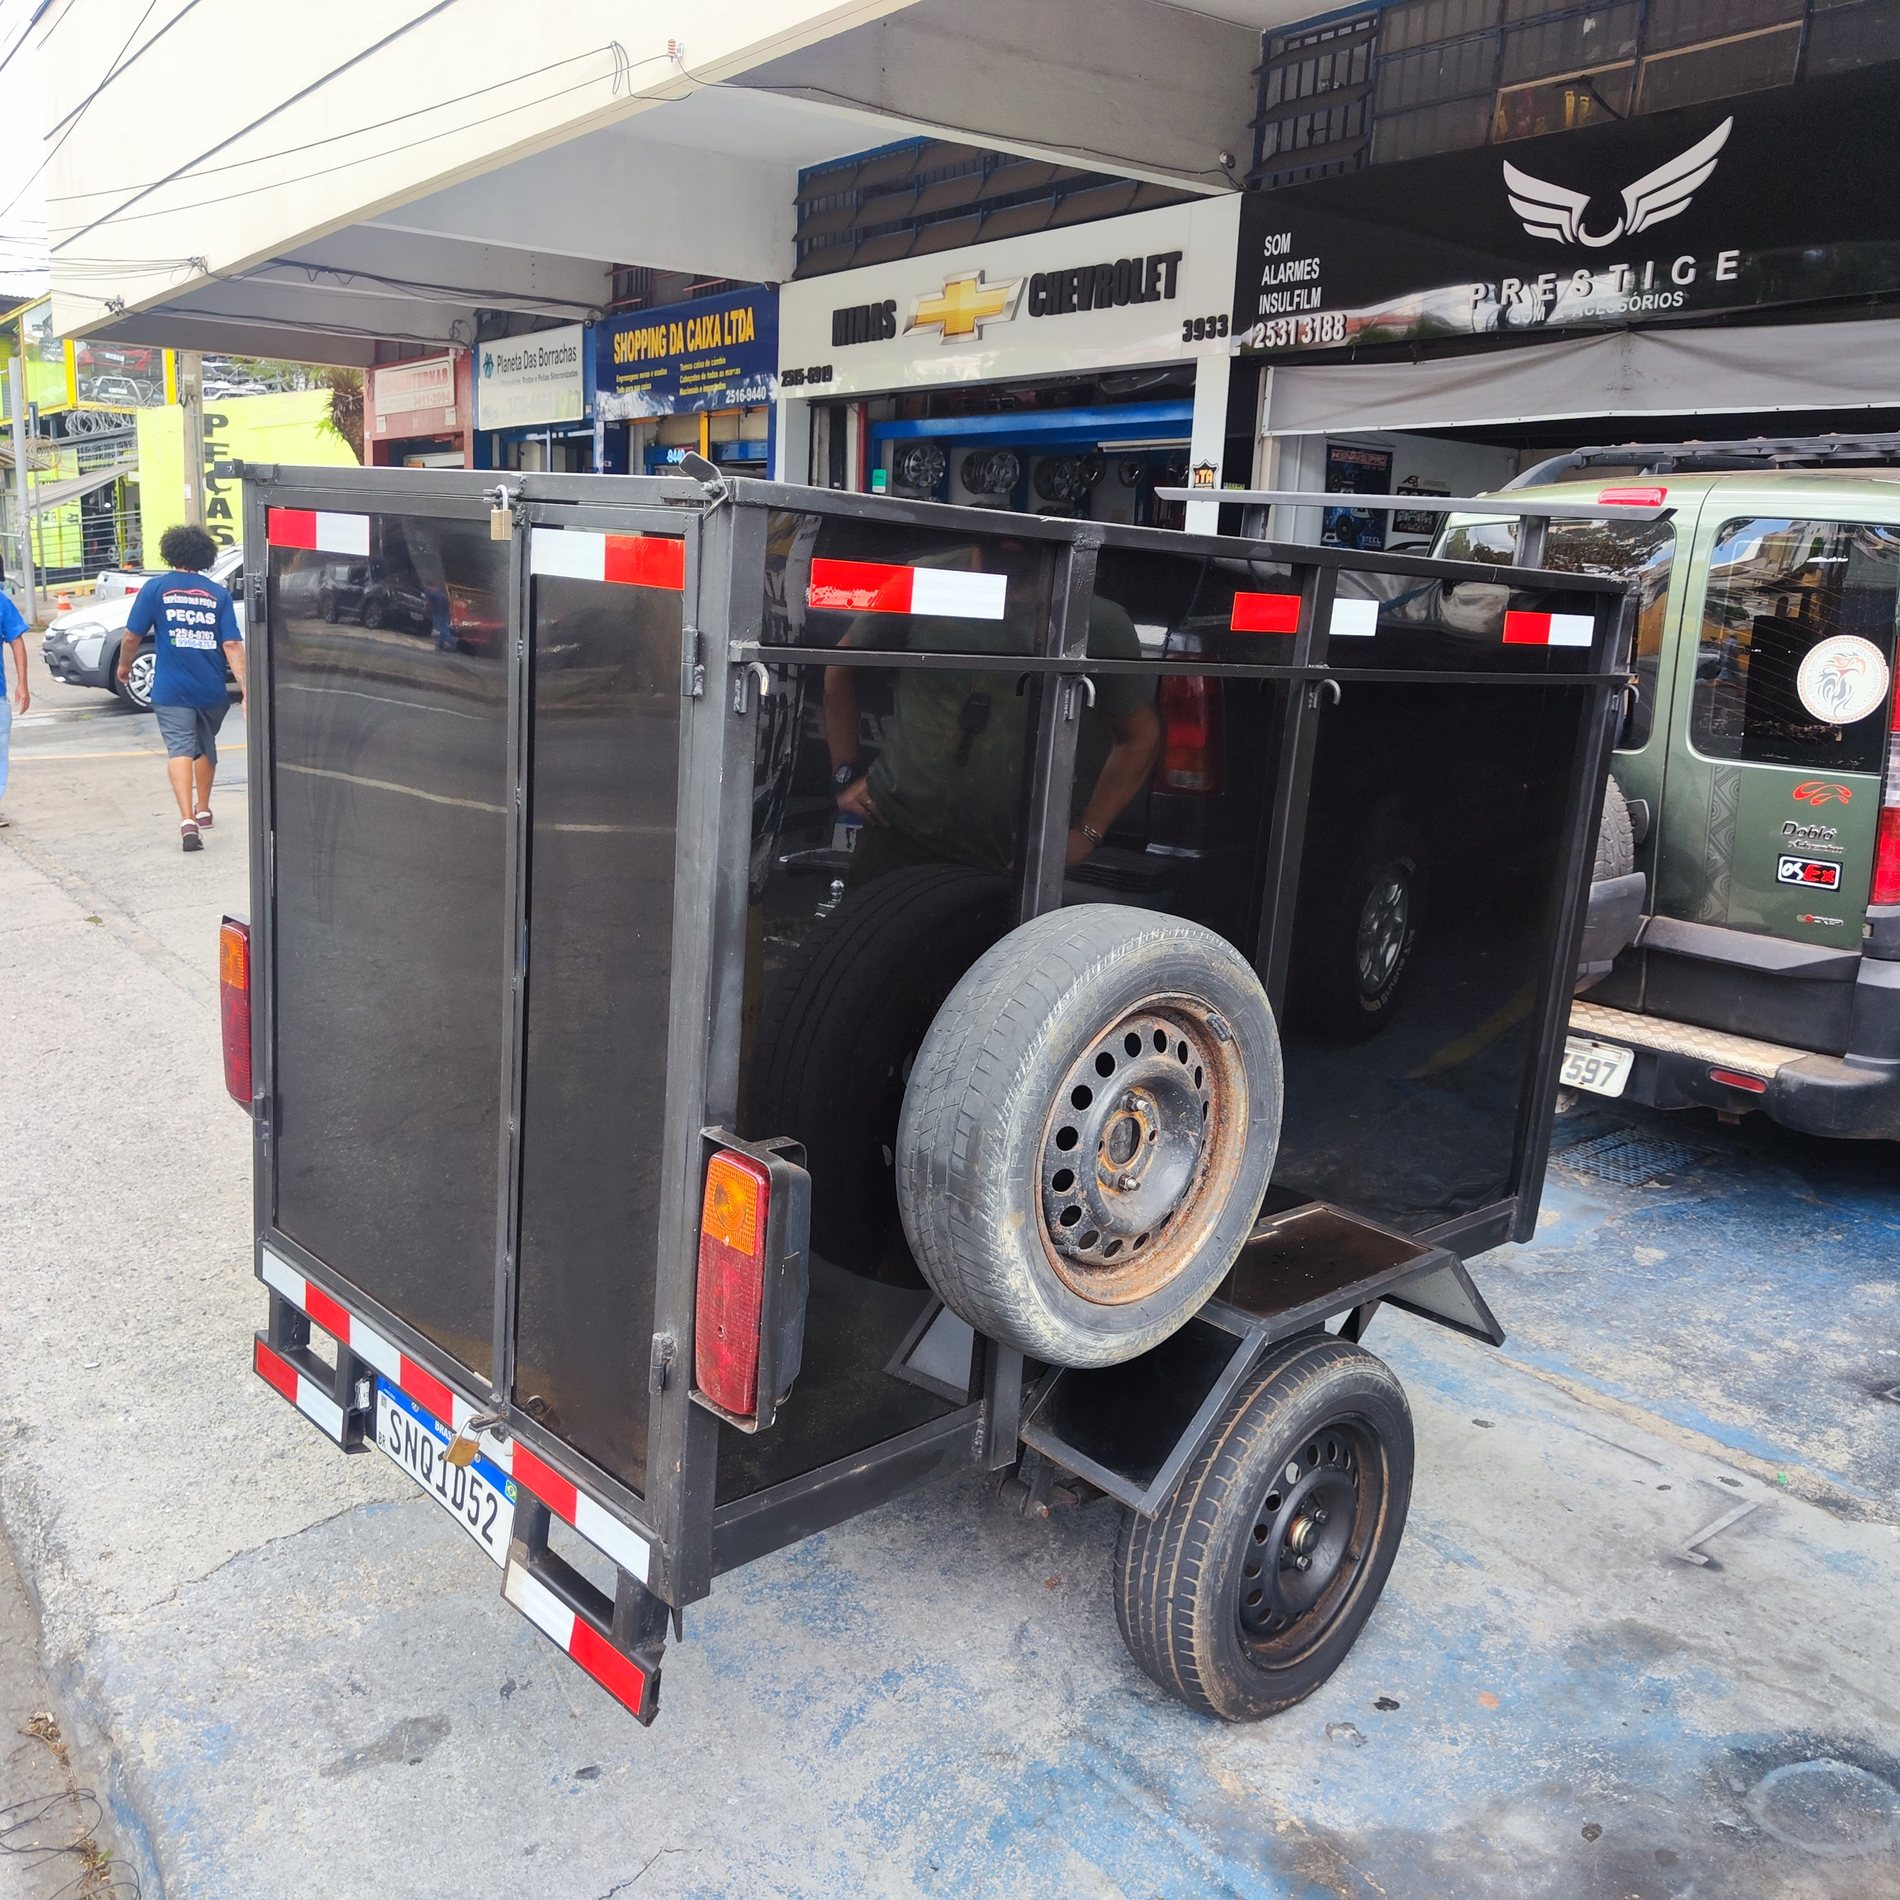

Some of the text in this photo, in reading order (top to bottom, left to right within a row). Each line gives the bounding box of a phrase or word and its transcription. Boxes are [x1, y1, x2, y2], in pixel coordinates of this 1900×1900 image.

[1264, 232, 1292, 256] SOM
[1261, 257, 1320, 286] ALARMES
[1470, 249, 1741, 309] PRESTIGE
[832, 250, 1183, 347] MINAS CHEVROLET
[1258, 286, 1322, 315] INSULFILM
[613, 306, 755, 364] SHOPPING DA CAIXA LTDA
[1182, 314, 1229, 343] 3933
[1254, 314, 1348, 349] 2531 3188
[496, 343, 577, 374] Planeta Das Borrachas
[725, 386, 767, 404] 2516-9440
[165, 608, 216, 625] PEÇAS
[1563, 1053, 1618, 1088] 597
[389, 1408, 499, 1547] SNQ1D52
